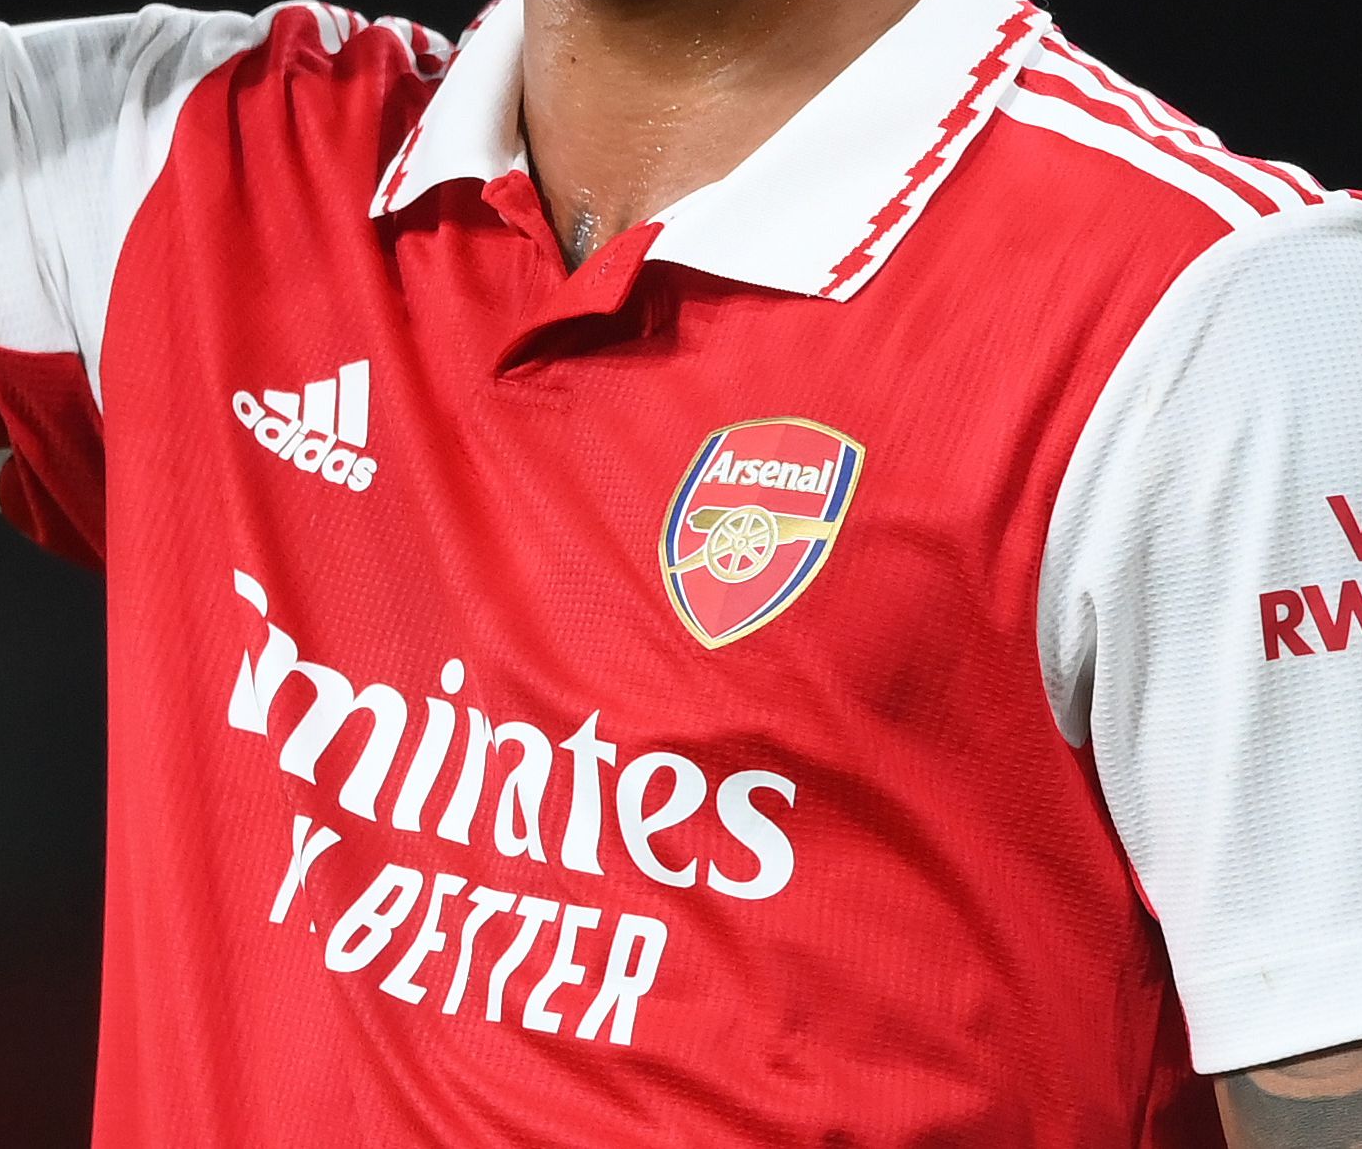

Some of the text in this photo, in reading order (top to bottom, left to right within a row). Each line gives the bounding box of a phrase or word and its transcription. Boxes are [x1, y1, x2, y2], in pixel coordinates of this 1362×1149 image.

[232, 390, 377, 492] adidas
[702, 450, 835, 495] Arsenal
[227, 568, 797, 900] mirates
[325, 862, 669, 1047] BETTER
